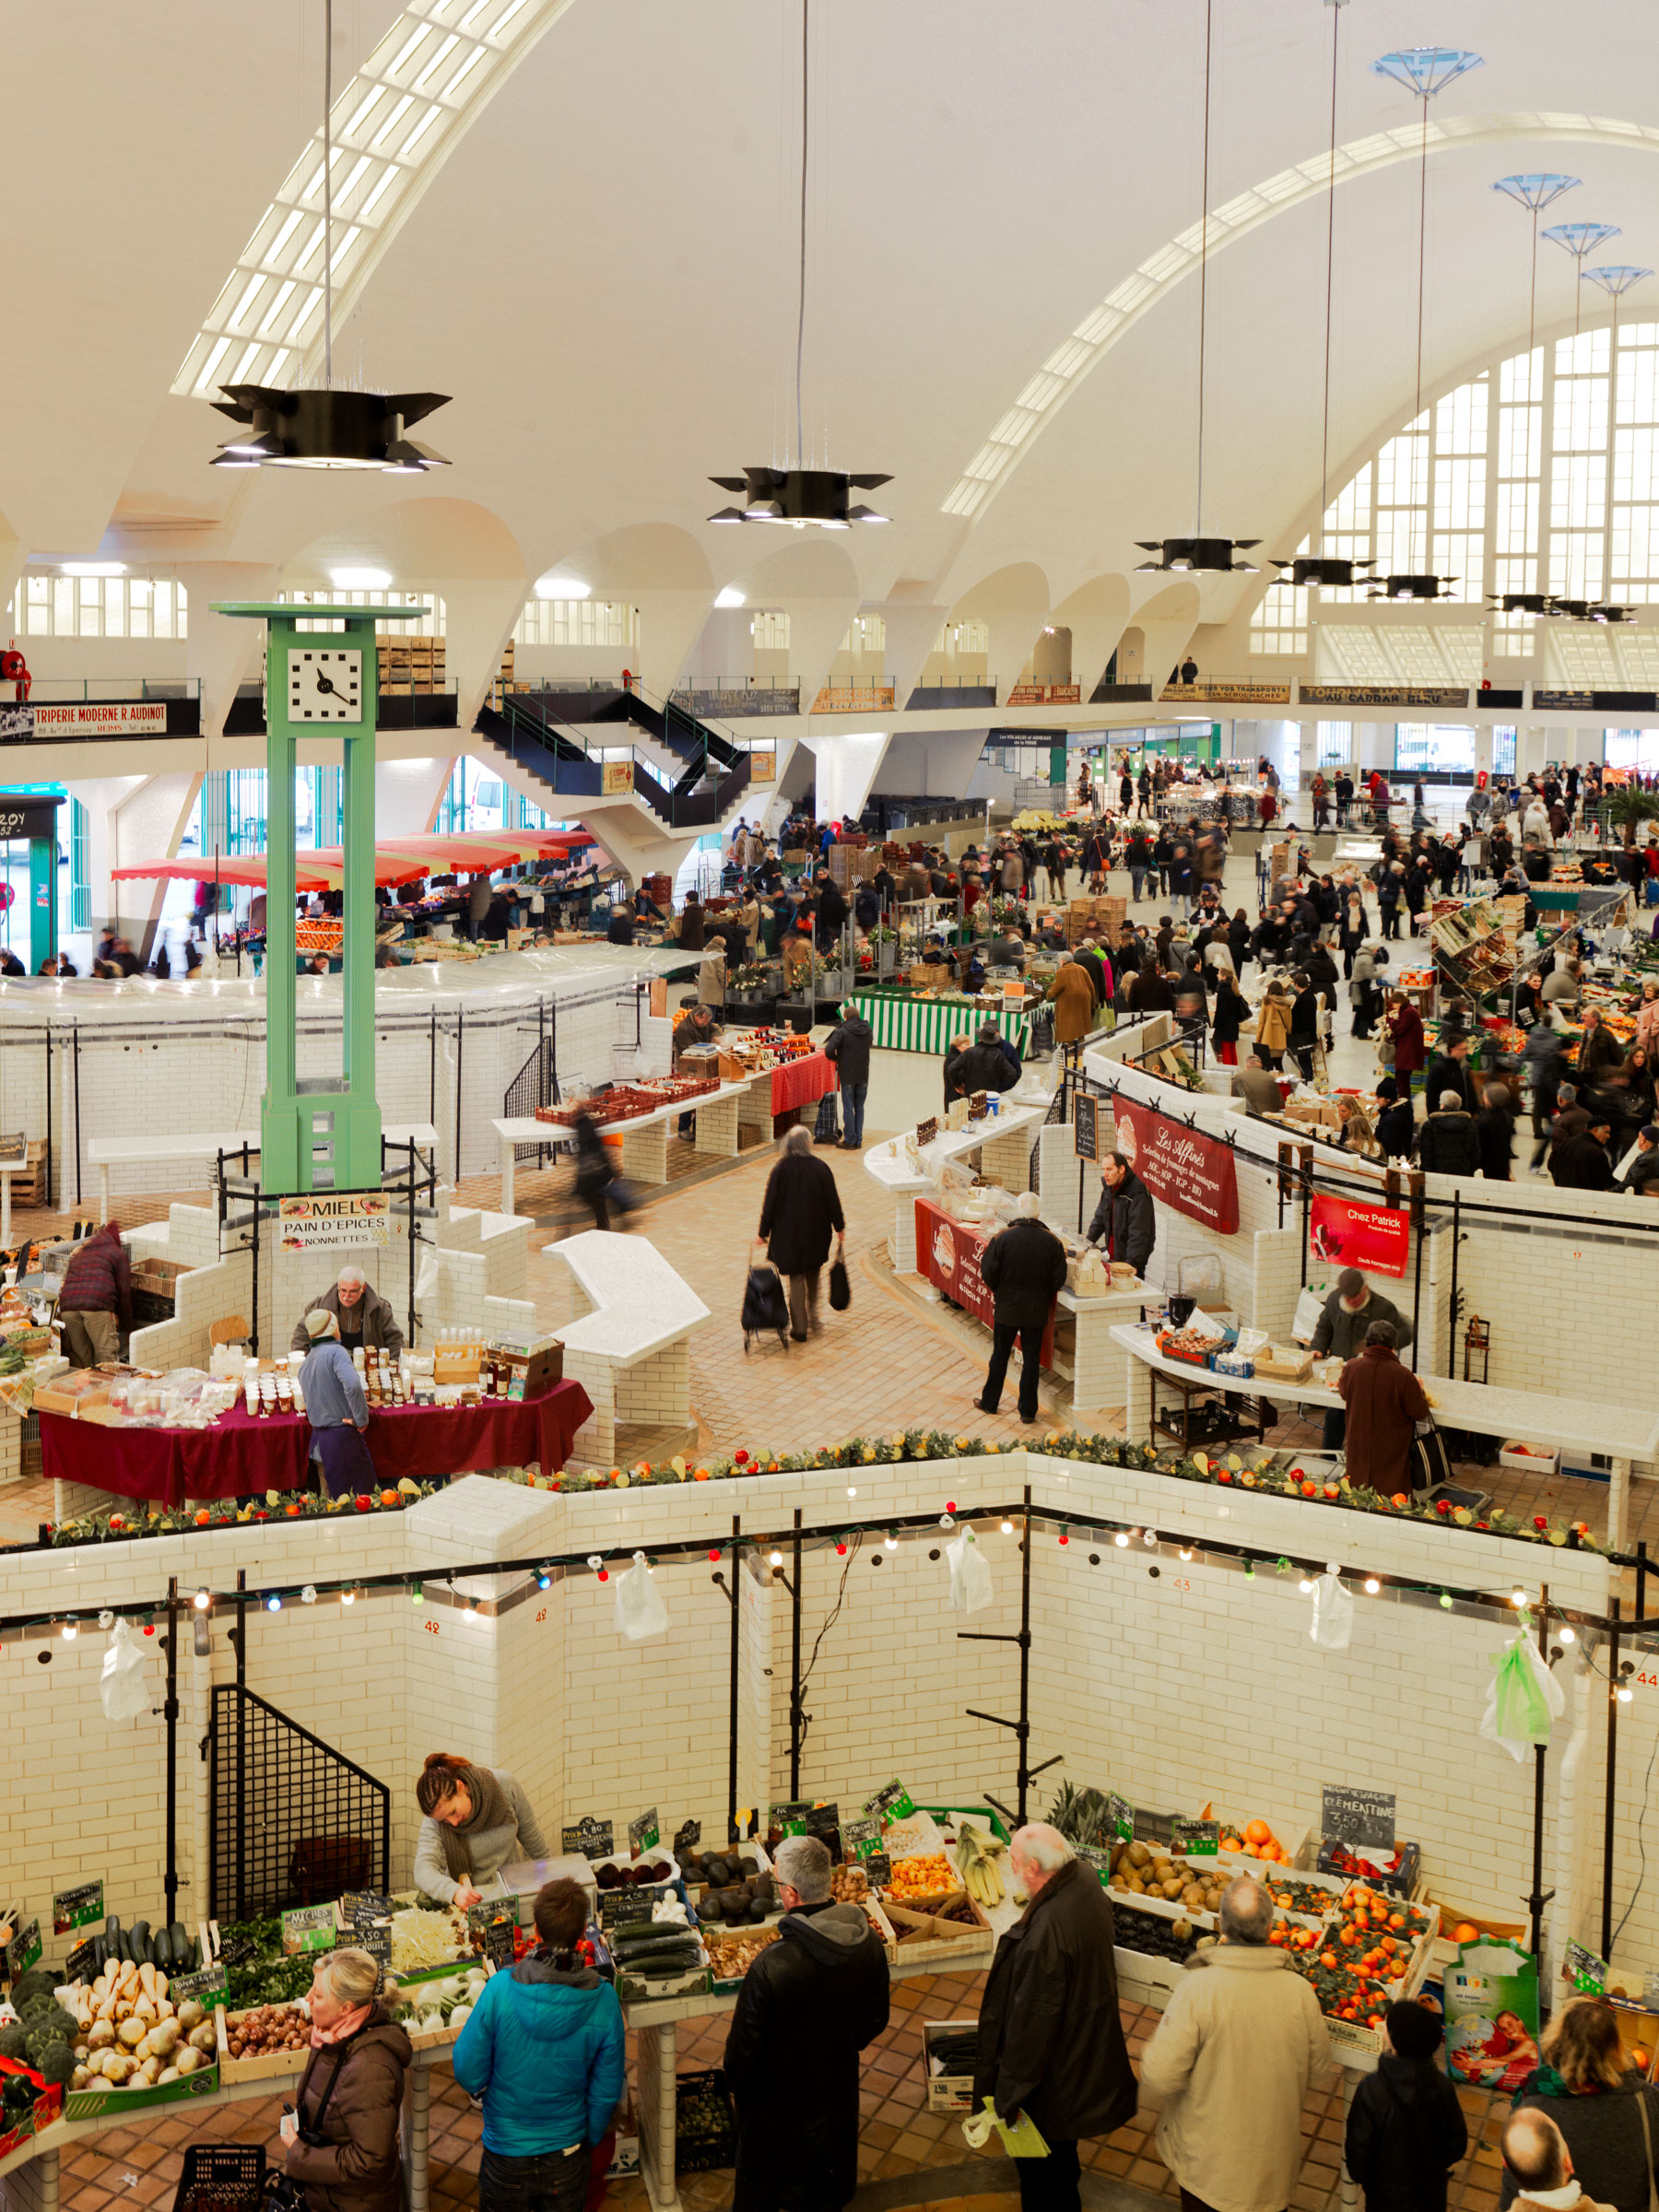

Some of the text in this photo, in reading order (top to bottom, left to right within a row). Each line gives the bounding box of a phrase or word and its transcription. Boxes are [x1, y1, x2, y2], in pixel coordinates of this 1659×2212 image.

[1325, 694, 1342, 702] AU
[1348, 693, 1399, 703] CADRAN
[1406, 693, 1441, 704] BLEU
[35, 708, 76, 724] TRIPERIE
[78, 707, 119, 723] MODERNE
[97, 724, 123, 733] REIMS
[1155, 1126, 1205, 1168] Les Affinés
[1160, 1154, 1166, 1165] de
[1165, 1158, 1188, 1176] fromages
[1188, 1168, 1195, 1179] de
[1194, 1172, 1220, 1192] montagnes
[1160, 1170, 1172, 1182] AOP
[1175, 1176, 1188, 1190] IGP
[1192, 1183, 1202, 1197] BIO
[312, 1200, 360, 1217] MIEL
[285, 1218, 385, 1233] PAIN D'EPICES
[1347, 1208, 1401, 1229] Chez Patrick
[305, 1234, 369, 1246] NONNETTES
[1572, 1252, 1583, 1261] 17
[977, 1283, 988, 1297] AOP
[1163, 1346, 1182, 1358] CARTE
[1173, 1578, 1191, 1592] 43
[535, 1607, 547, 1623] 42
[424, 1620, 440, 1635] 42
[1637, 1672, 1658, 1688] 44
[1329, 1811, 1359, 1832] 3,50
[562, 1831, 576, 1840] Prix
[344, 1892, 357, 1901] Prix
[604, 1895, 618, 1903] Prix
[336, 1933, 351, 1943] Prix
